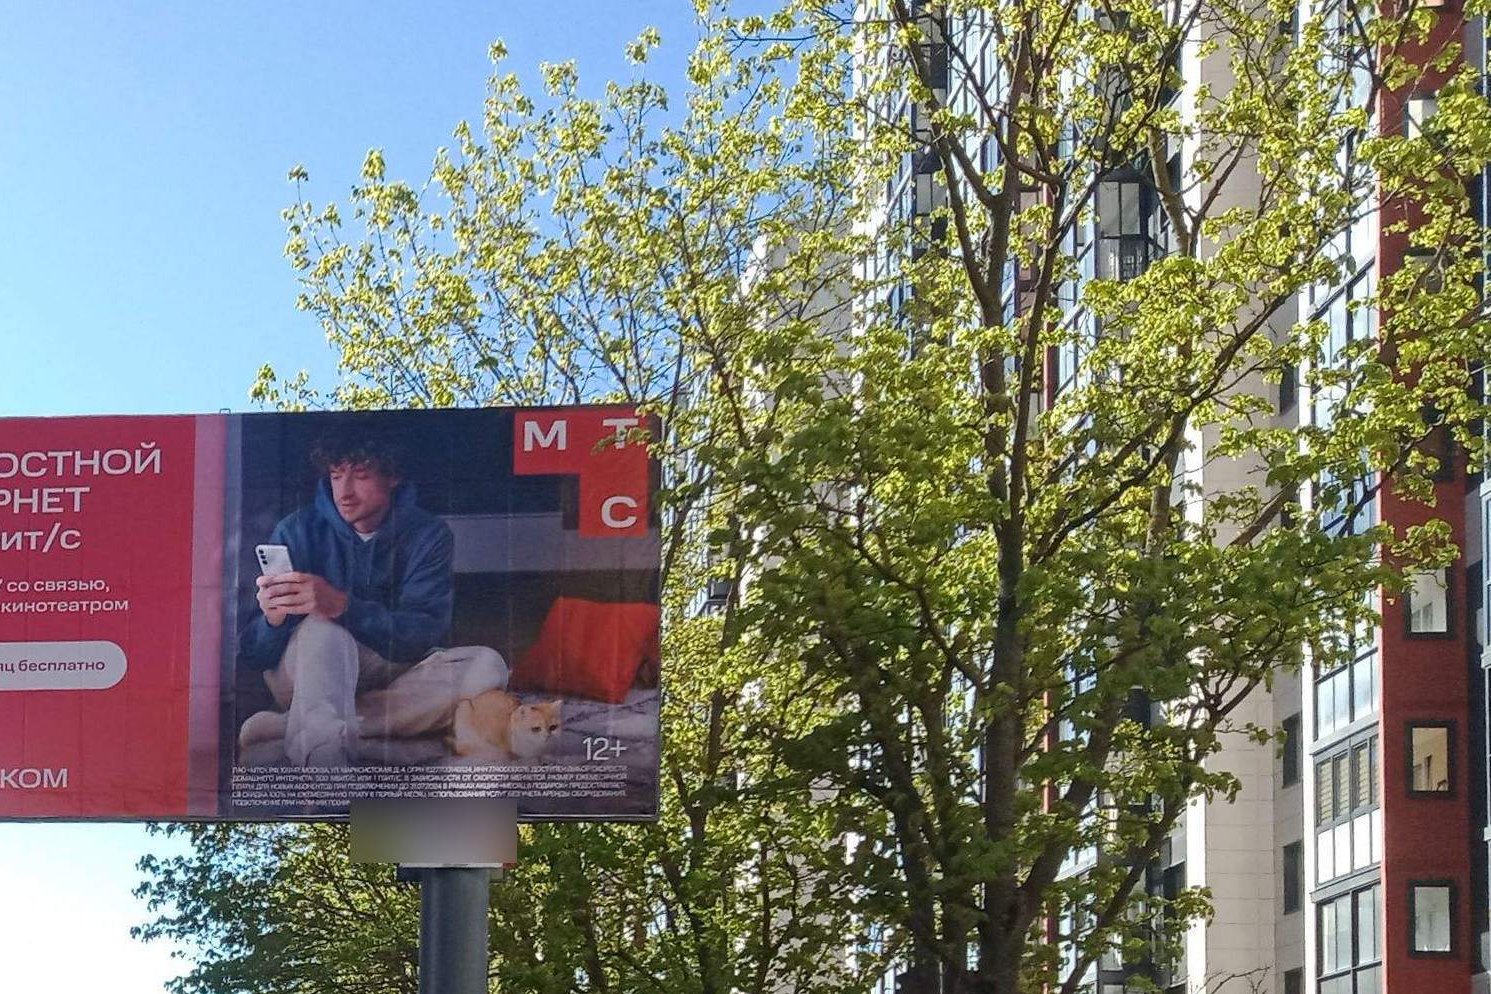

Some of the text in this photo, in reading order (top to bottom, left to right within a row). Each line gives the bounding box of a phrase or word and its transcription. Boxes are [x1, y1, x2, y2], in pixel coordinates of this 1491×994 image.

[6, 581, 30, 593] со
[33, 579, 110, 595] связью,
[18, 658, 106, 674] бесплатно
[582, 737, 628, 761] 12+
